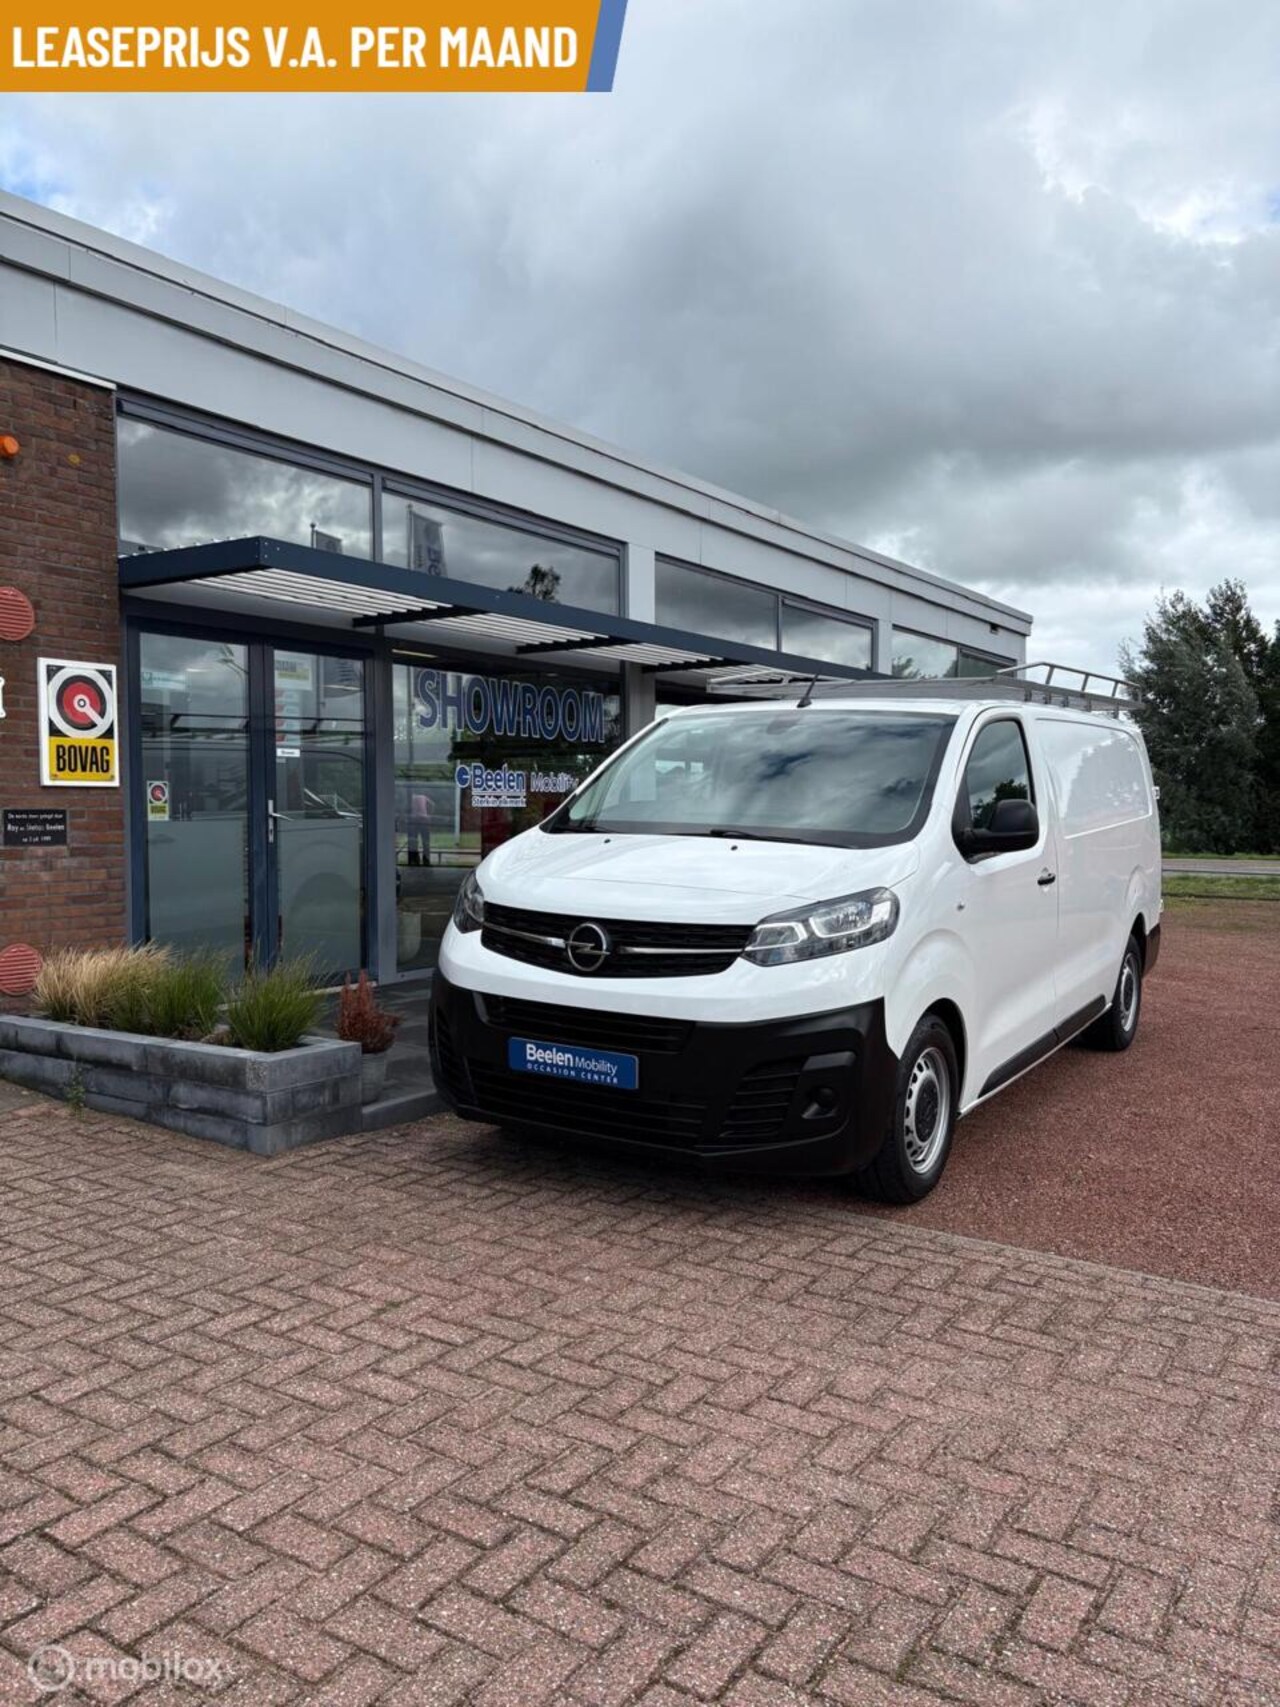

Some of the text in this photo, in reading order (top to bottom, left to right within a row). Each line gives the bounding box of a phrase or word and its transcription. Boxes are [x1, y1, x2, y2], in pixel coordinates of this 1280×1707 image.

[418, 669, 605, 743] SHOWROOM
[56, 744, 110, 773] BOVAG
[472, 763, 525, 791] Beelen
[526, 1043, 618, 1076] Beelen Mobility
[527, 1063, 618, 1084] OCCASION CENTER
